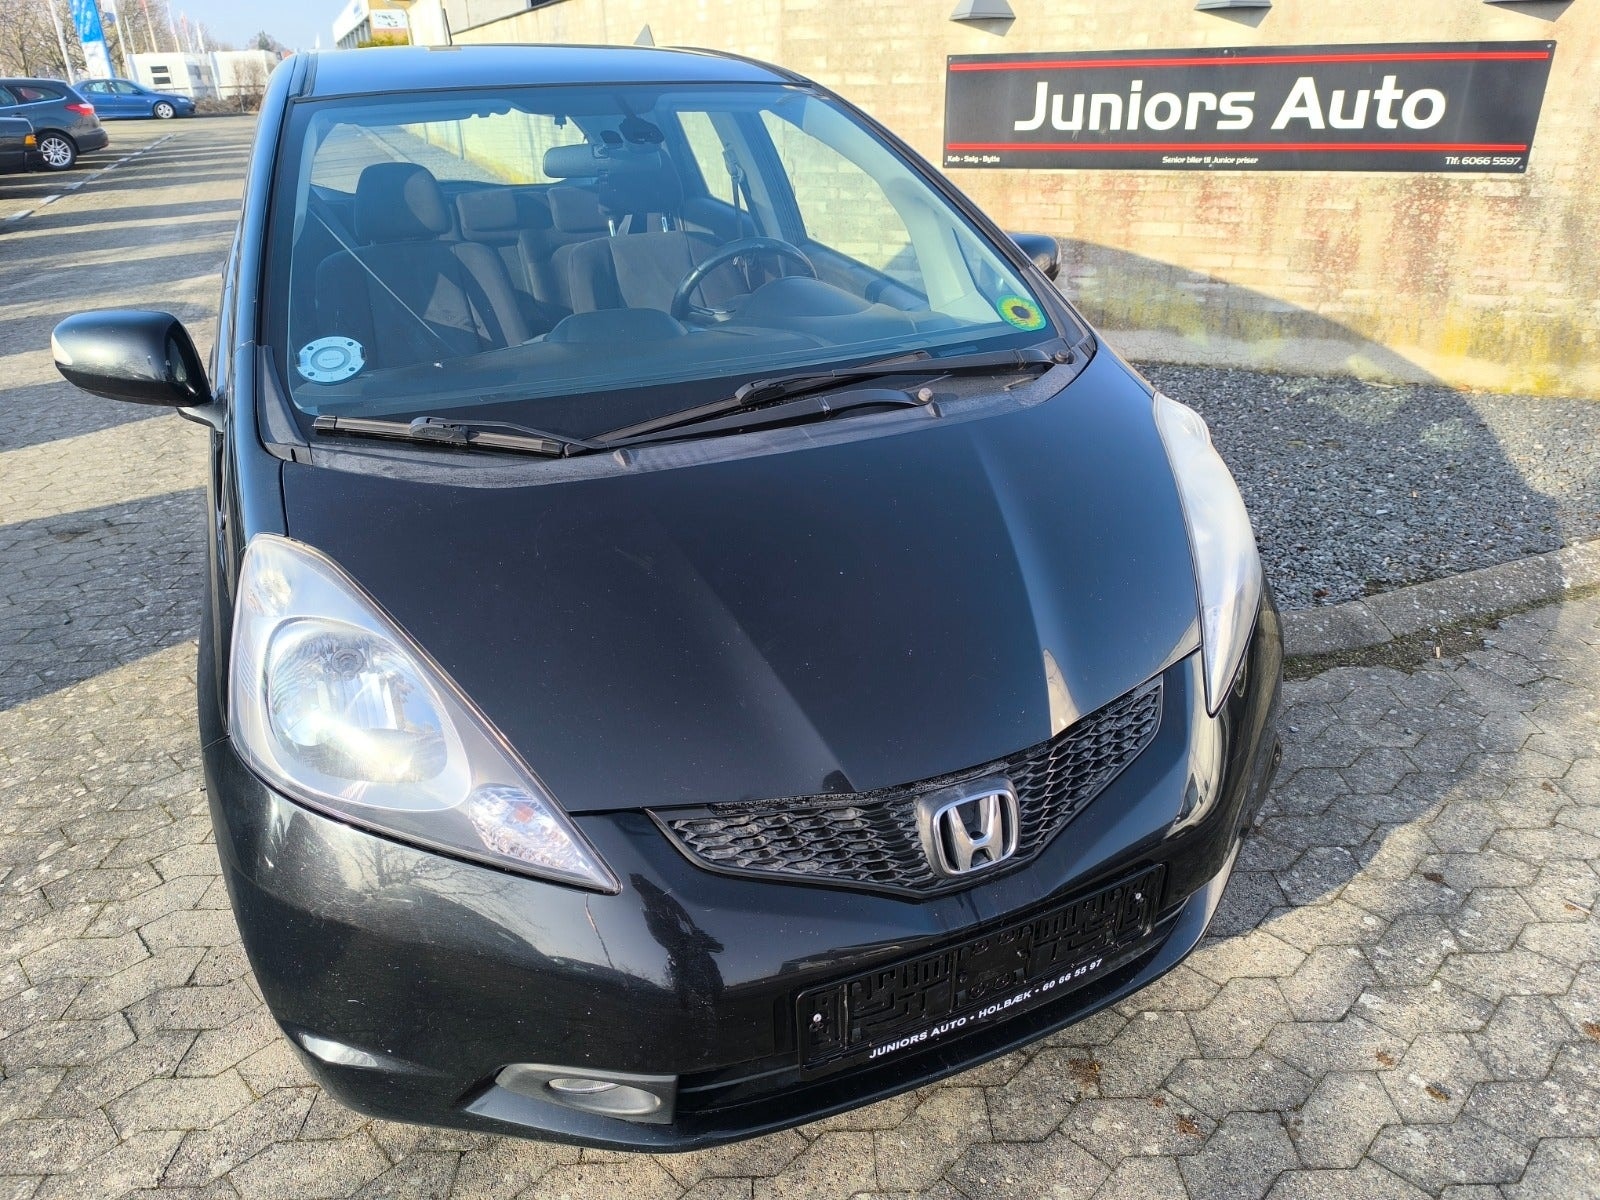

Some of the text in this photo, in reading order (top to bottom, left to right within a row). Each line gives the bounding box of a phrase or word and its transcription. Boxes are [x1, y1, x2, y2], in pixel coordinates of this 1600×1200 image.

[1014, 75, 1446, 131] Juniors Auto
[1162, 156, 1259, 165] Senior biler til Junior priser
[1461, 156, 1491, 165] 6066
[1492, 156, 1521, 165] 5597
[869, 958, 1103, 1059] JUNIORS AUTO HOLBÆK 60 66 55 97
